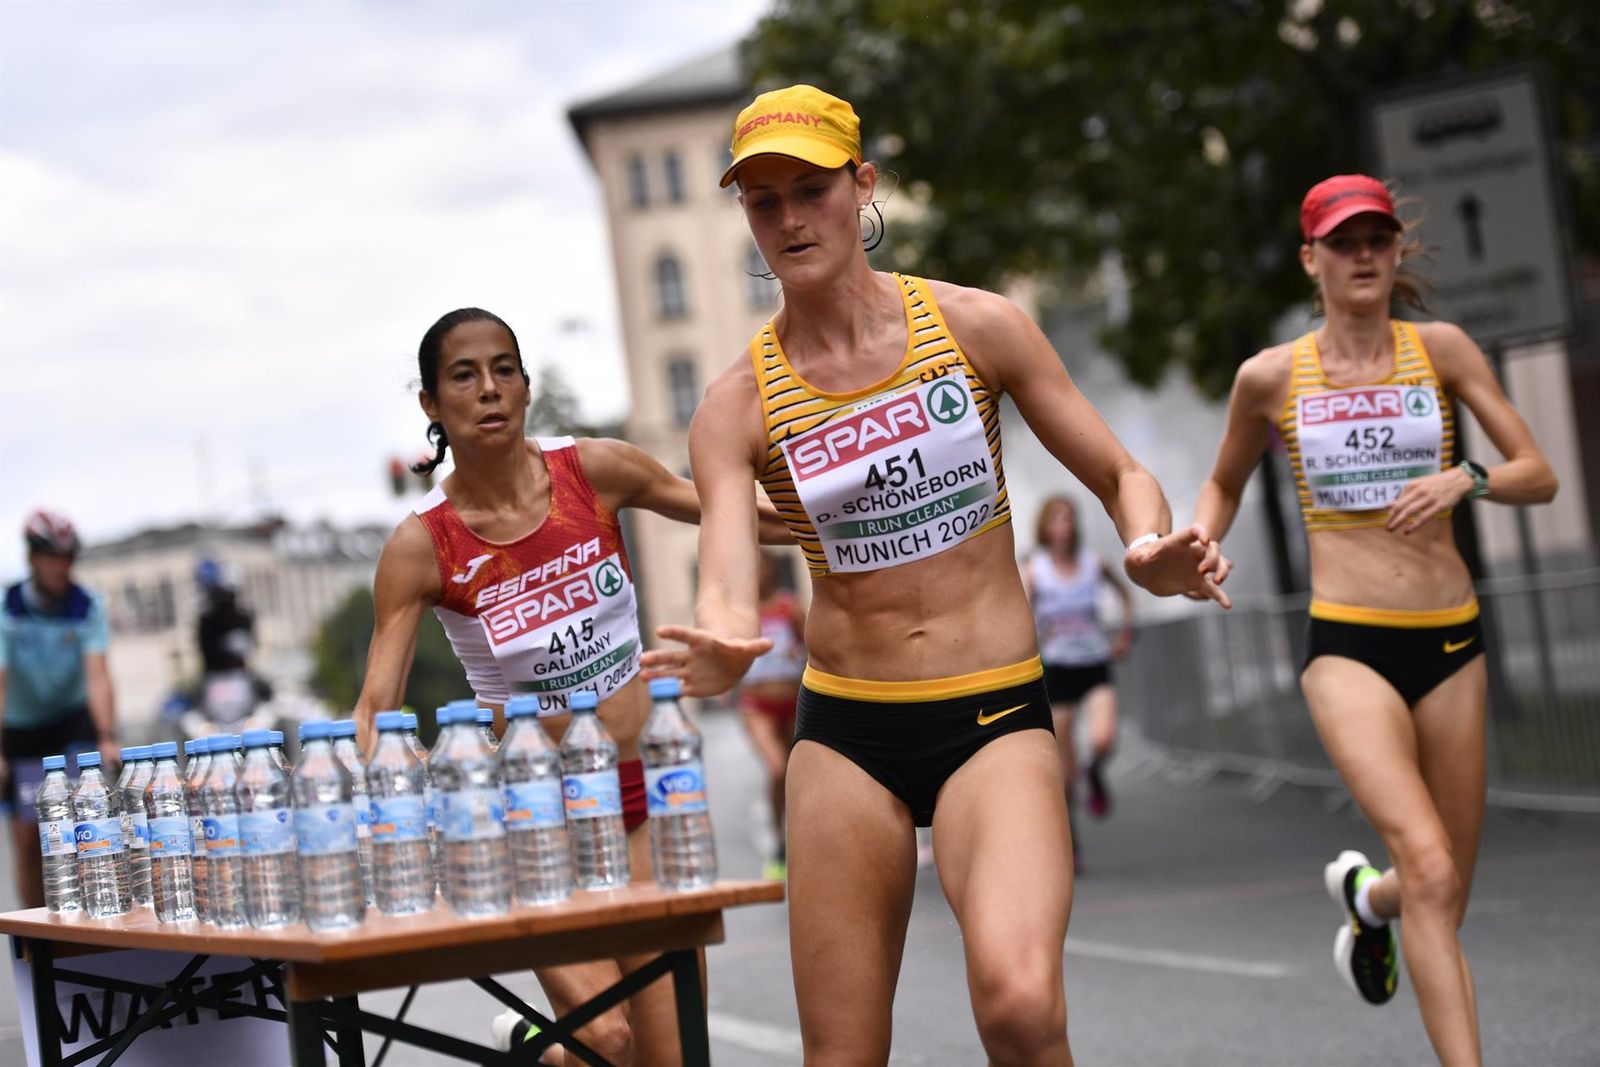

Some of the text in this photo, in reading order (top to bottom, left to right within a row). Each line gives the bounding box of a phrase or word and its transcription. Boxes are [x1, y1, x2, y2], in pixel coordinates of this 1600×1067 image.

[1303, 391, 1399, 423] SPAR
[794, 400, 925, 475] SPAR
[1345, 426, 1395, 450] 452
[816, 457, 988, 524] D. SCHÖNEBORN
[864, 448, 926, 491] 451
[1317, 486, 1387, 505] MUNICH
[835, 503, 989, 565] MUNICH 2022
[858, 522, 864, 536] I
[867, 517, 902, 535] RUN
[475, 536, 600, 608] ESPAÑA
[490, 580, 594, 640] SPAR
[533, 632, 611, 675] GALIMANY
[548, 616, 594, 656] 415
[541, 682, 546, 691] I
[549, 676, 578, 689] RUN
